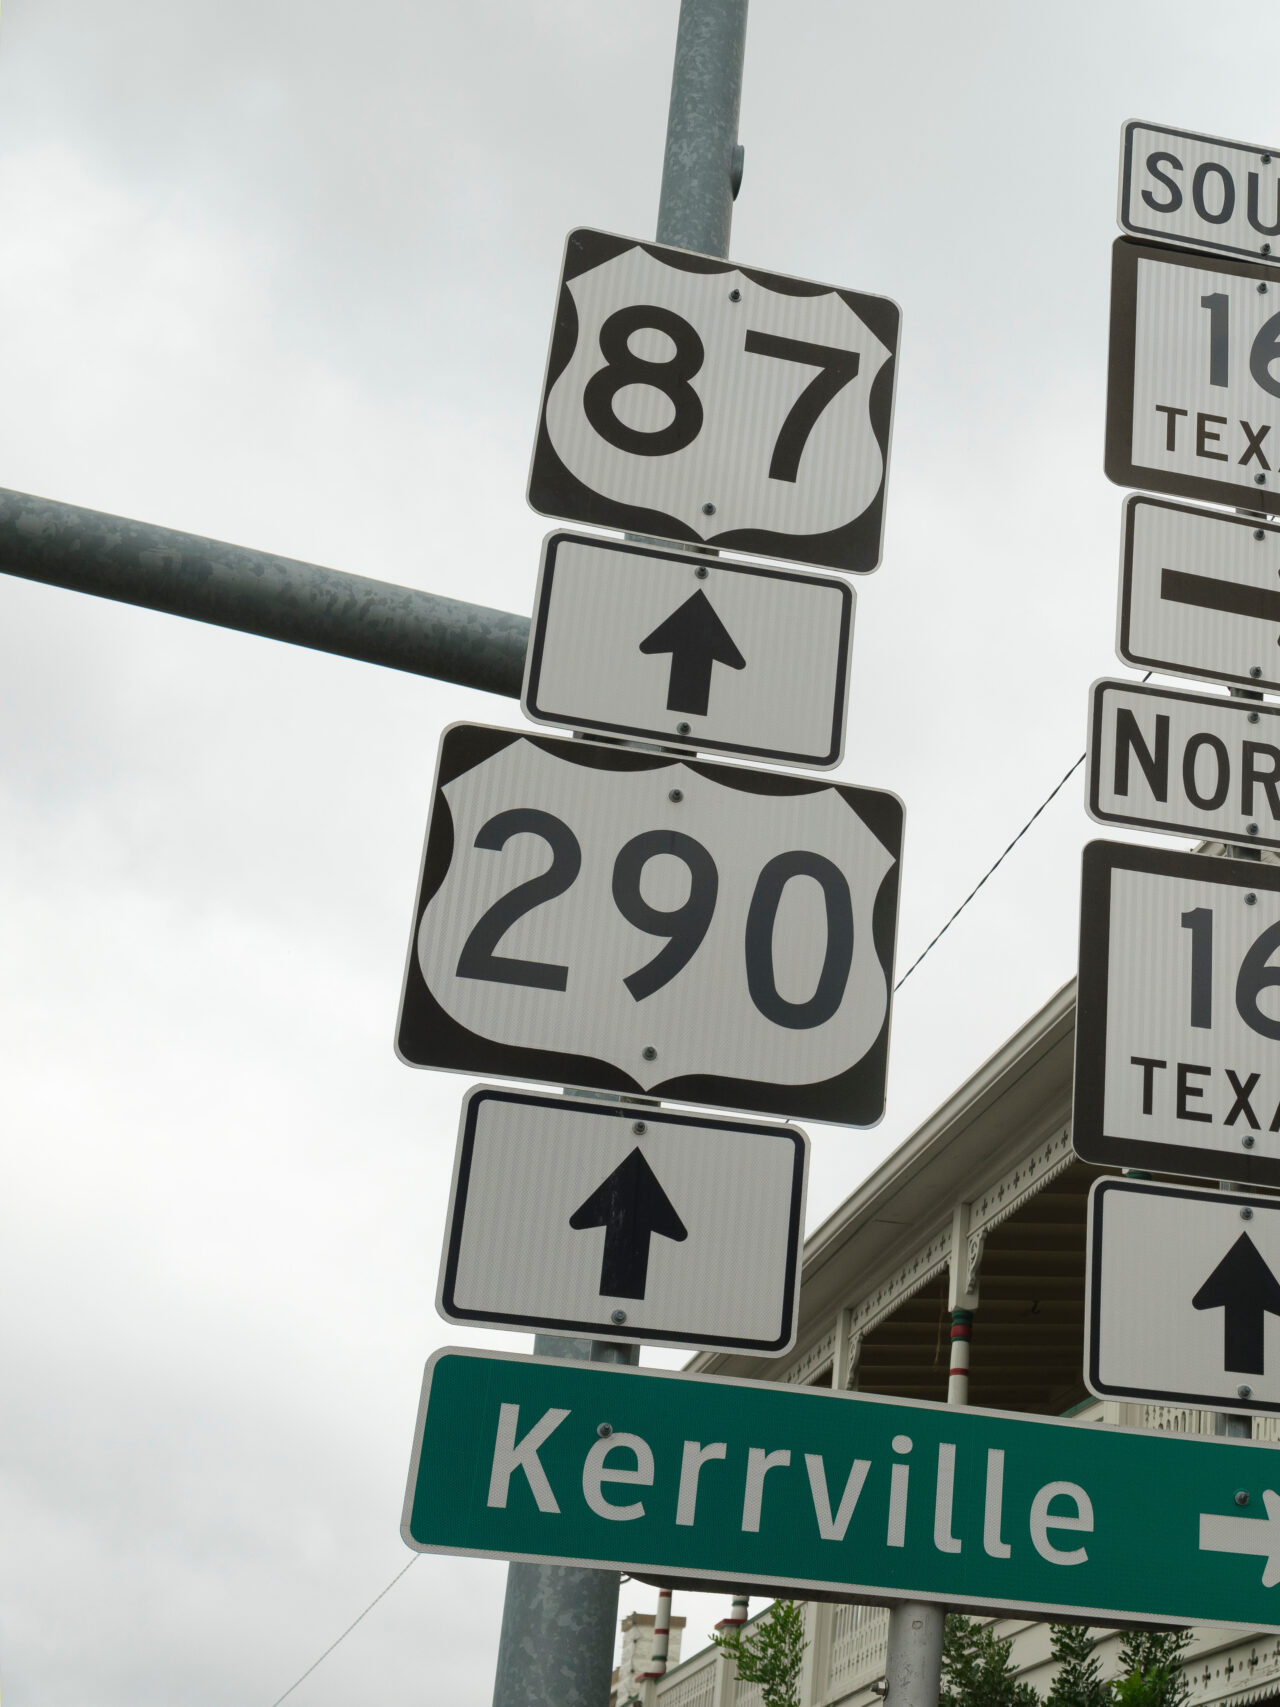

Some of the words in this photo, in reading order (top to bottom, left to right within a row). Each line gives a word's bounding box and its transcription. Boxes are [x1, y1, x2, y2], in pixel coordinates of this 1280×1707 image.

[583, 304, 860, 483] 87
[455, 808, 854, 1030] 290
[486, 1403, 1094, 1566] Kerrville
